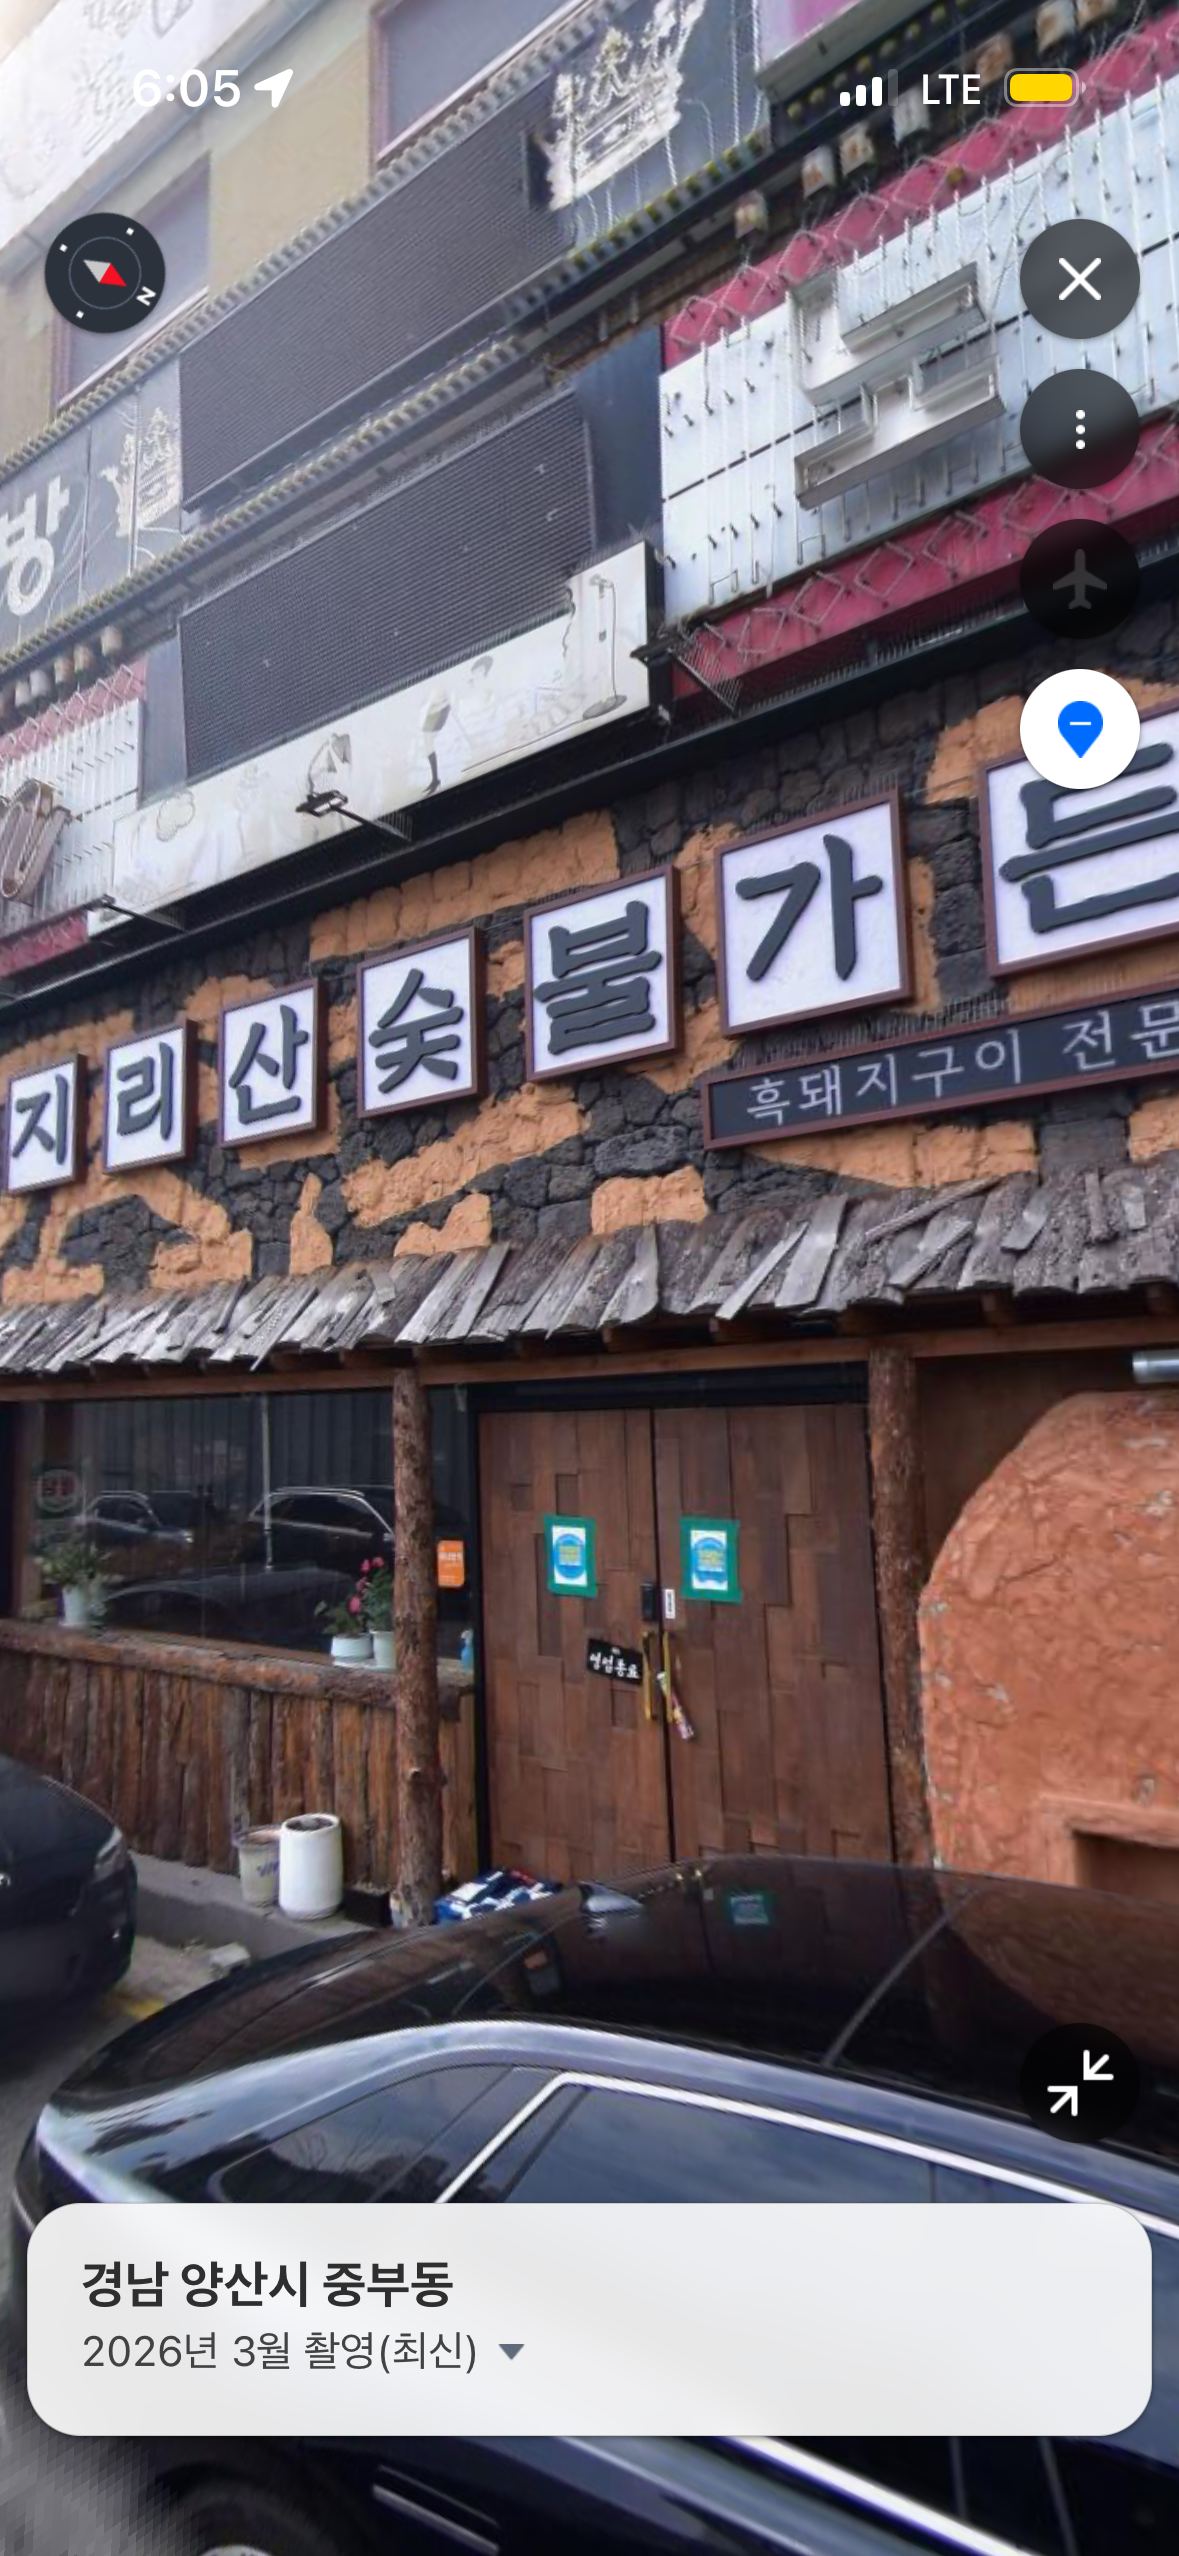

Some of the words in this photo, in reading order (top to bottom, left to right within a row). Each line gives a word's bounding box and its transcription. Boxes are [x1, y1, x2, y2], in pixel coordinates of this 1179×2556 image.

[746, 1028, 1022, 1126] 흑돼지구이
[1062, 999, 1179, 1070] 전문
[589, 1651, 640, 1679] 영업종료
